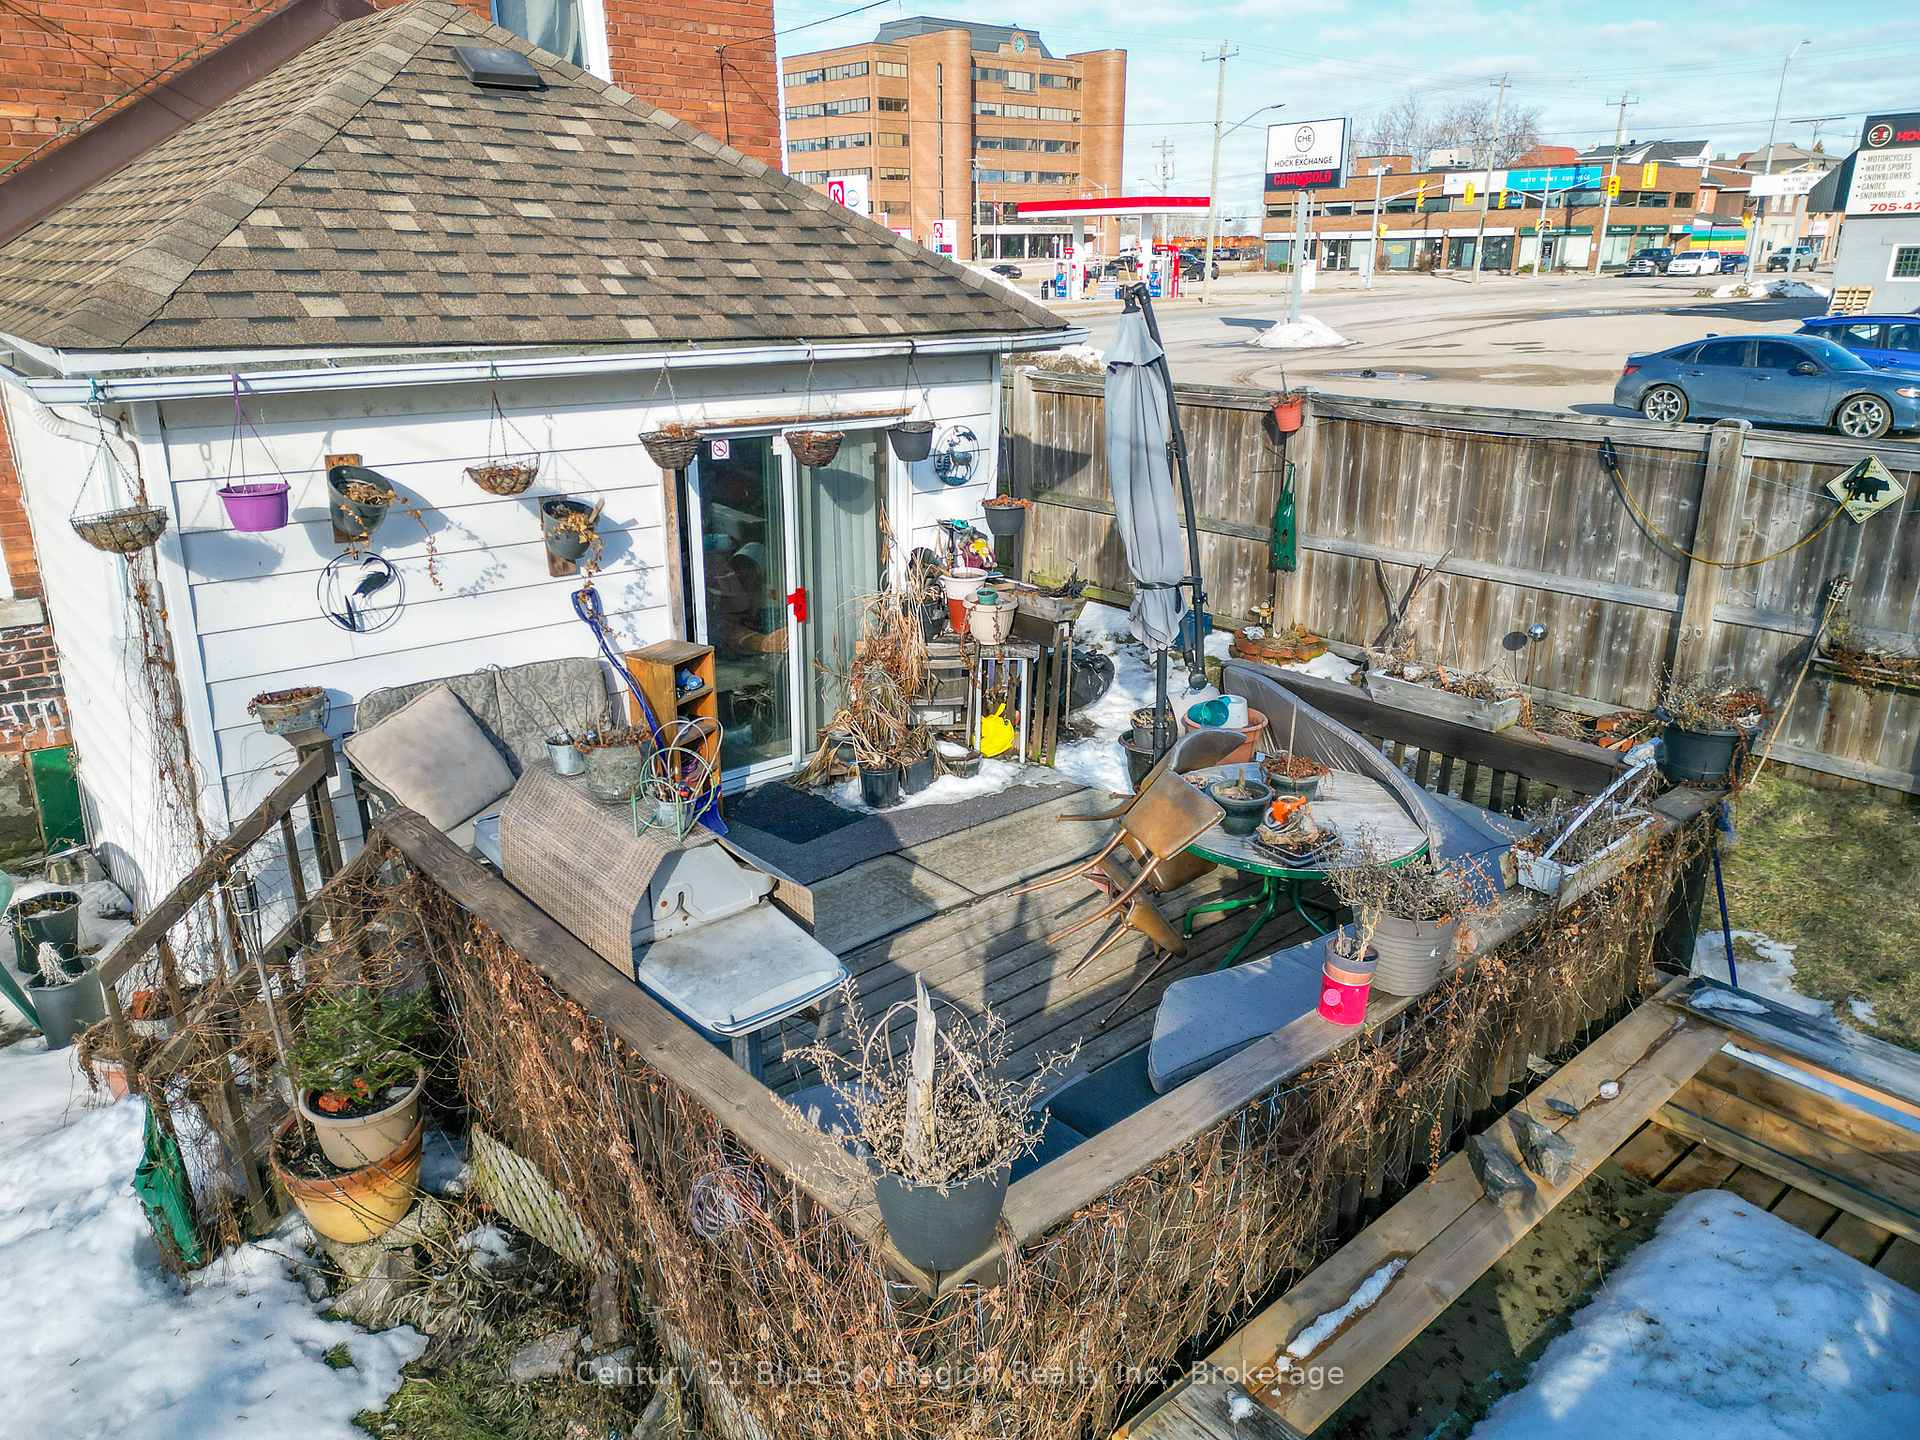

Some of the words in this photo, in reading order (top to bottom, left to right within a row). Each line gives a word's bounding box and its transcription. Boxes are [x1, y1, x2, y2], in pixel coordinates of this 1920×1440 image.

[1295, 156, 1333, 166] EXCHANGE
[1867, 153, 1912, 163] MOTORCYCLES
[1865, 164, 1886, 172] WATER
[1888, 163, 1912, 171] SPORTS
[1863, 172, 1912, 181] SNOWBLOWERS
[1861, 182, 1886, 190] CANOES
[1860, 191, 1905, 200] SNOWMOBILES
